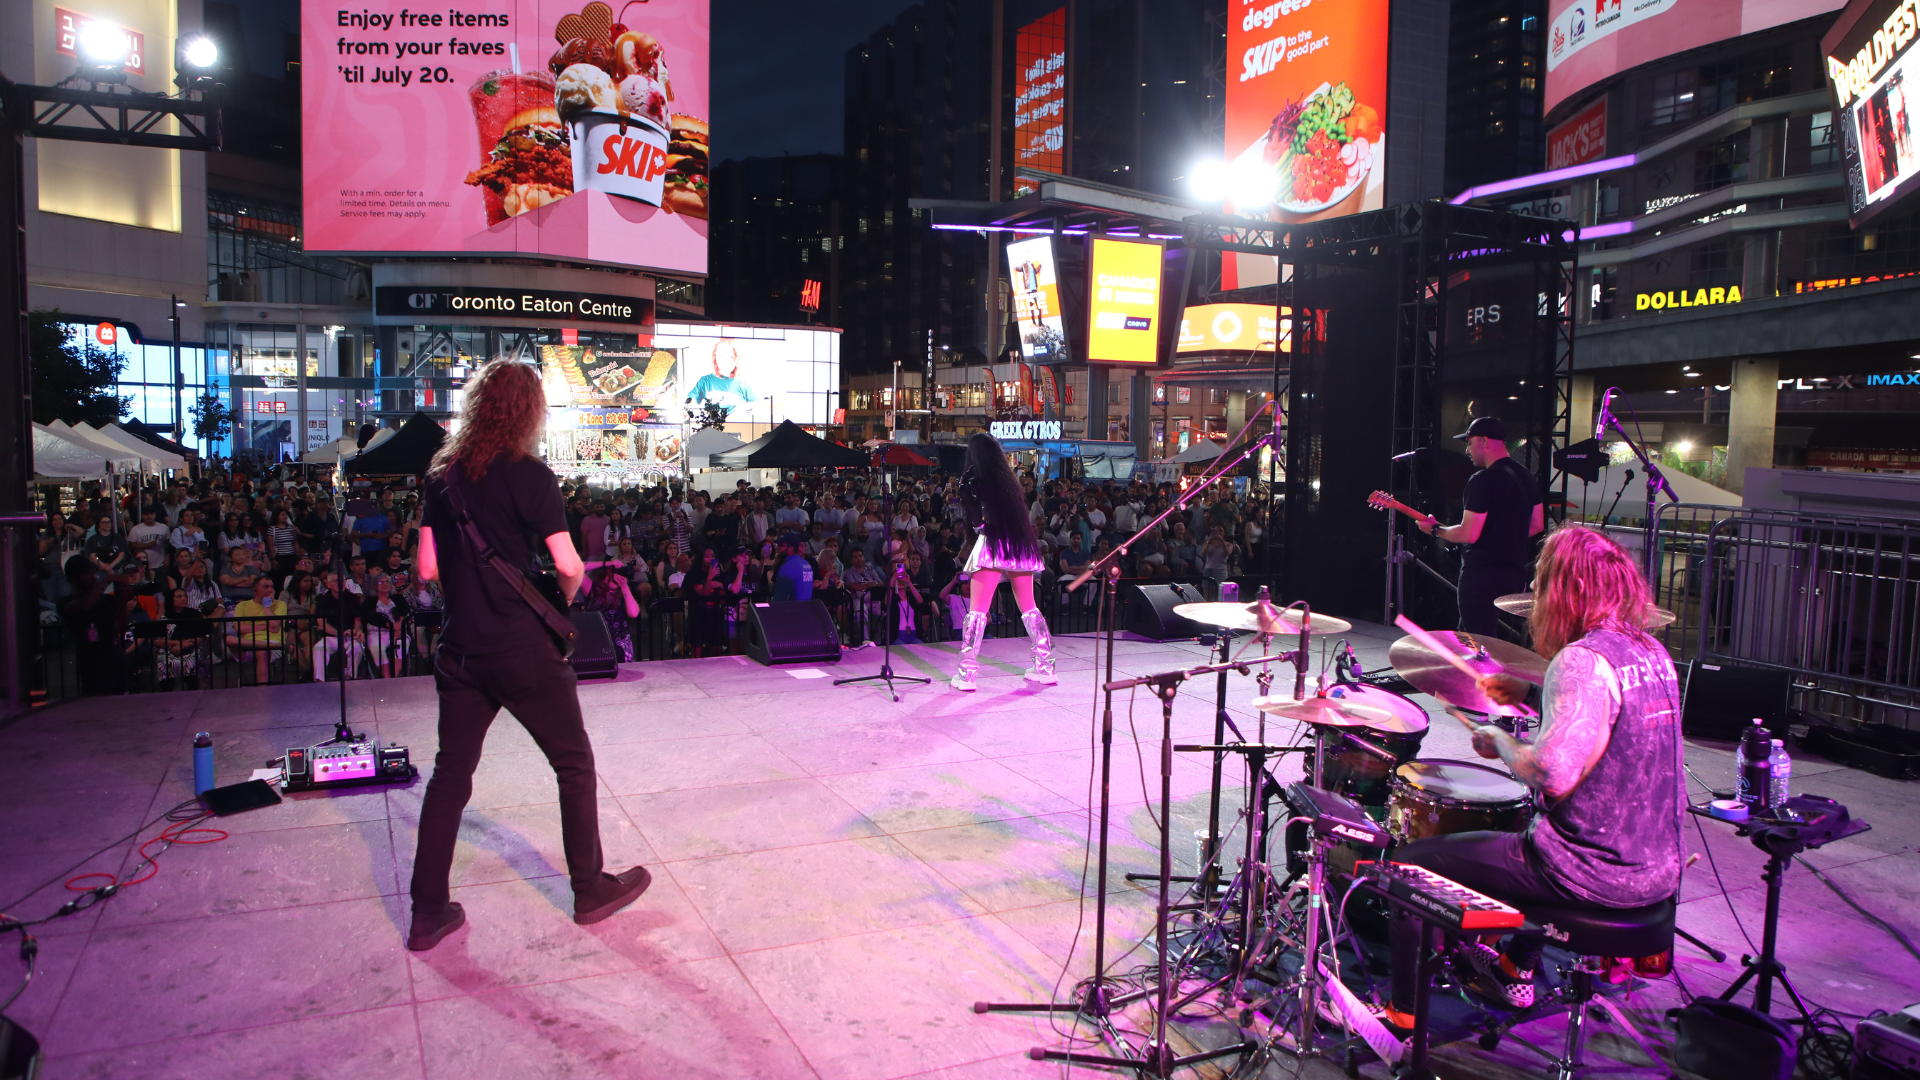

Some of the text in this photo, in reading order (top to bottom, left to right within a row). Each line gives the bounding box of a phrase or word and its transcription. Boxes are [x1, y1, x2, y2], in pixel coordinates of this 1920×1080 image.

[337, 9, 509, 31] Enjoy free items
[1242, 0, 1312, 32] degrees
[337, 37, 505, 59] from your faves
[1287, 30, 1312, 47] to the
[1287, 35, 1329, 62] good part
[1240, 36, 1287, 82] SKIP
[338, 65, 454, 87] 'til July 20.
[597, 134, 667, 182] SKIP
[340, 189, 358, 197] With
[340, 199, 367, 207] limited
[368, 199, 387, 207] time.
[389, 199, 415, 207] Details
[369, 209, 385, 217] fees
[386, 211, 402, 219] may
[404, 210, 427, 218] apply.
[408, 293, 632, 318] CF Toronto Eaton Centre
[1635, 285, 1742, 311] DOLLARA
[1867, 374, 1920, 386] IMAX
[990, 420, 1061, 439] GREEK GYROS
[1829, 452, 1864, 461] CANADA
[1890, 455, 1909, 463] ENTER
[1331, 824, 1375, 842] ALESIS
[1410, 893, 1429, 906] AKAI
[1428, 900, 1447, 916] MPK
